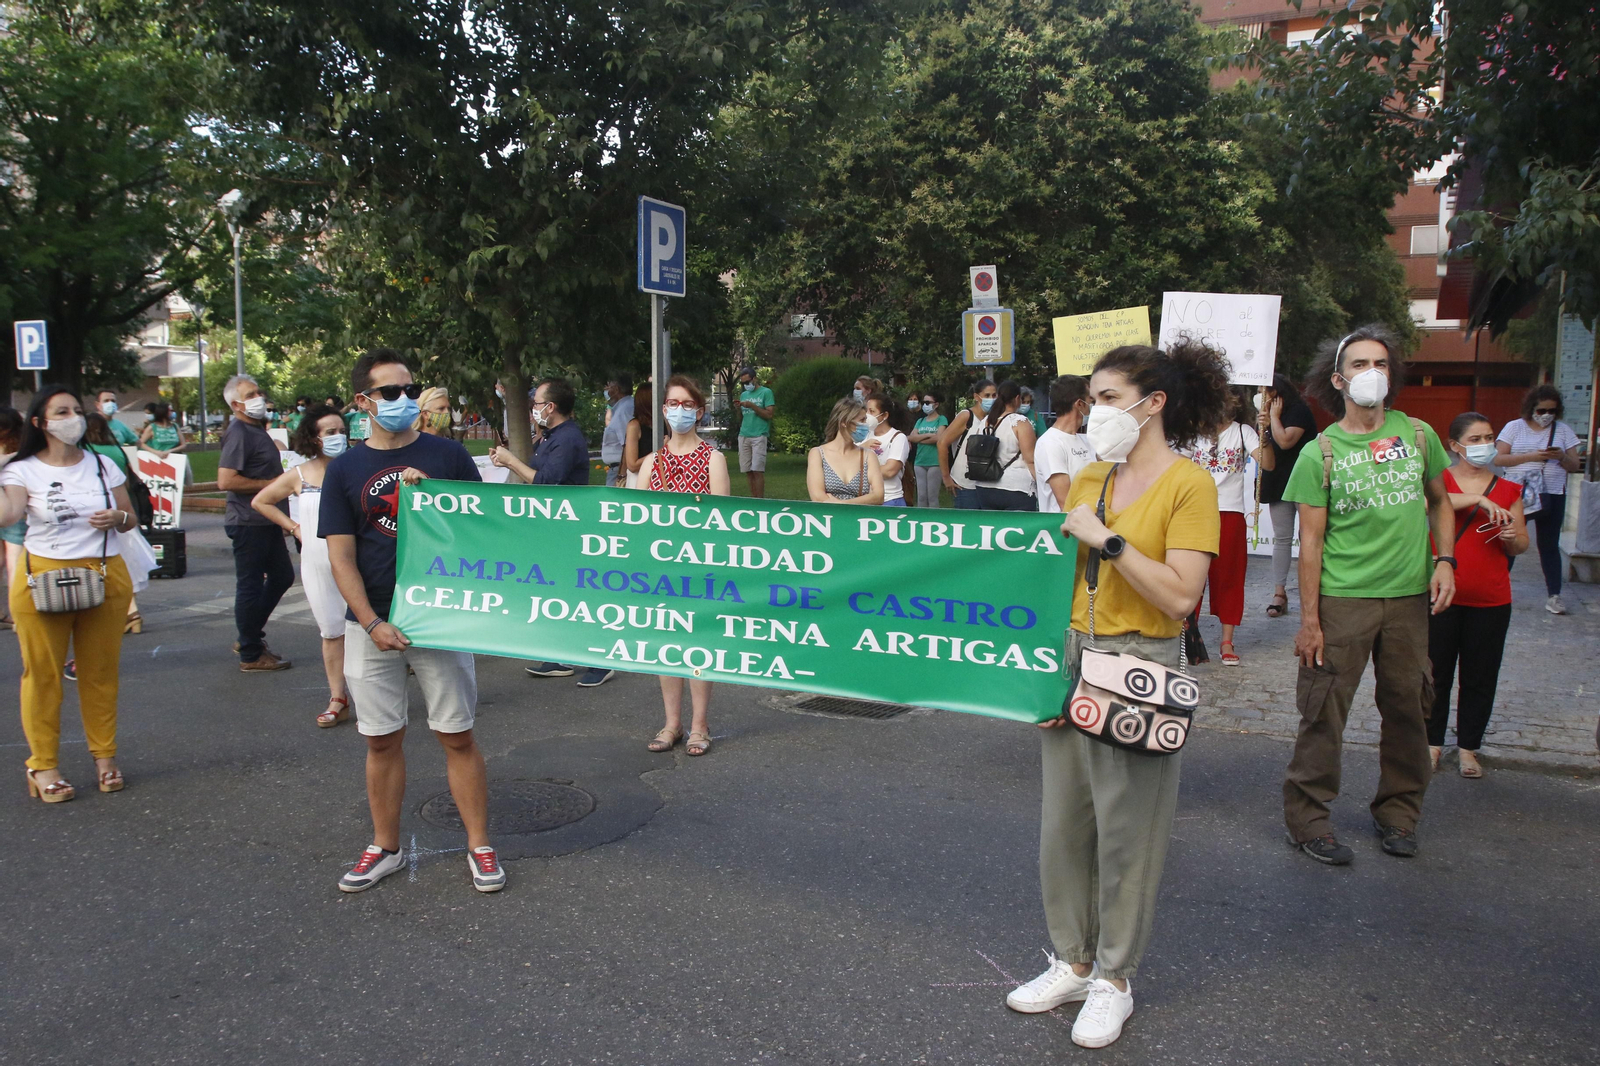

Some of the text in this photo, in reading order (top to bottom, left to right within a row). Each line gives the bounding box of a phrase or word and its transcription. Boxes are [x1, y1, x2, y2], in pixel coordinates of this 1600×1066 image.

[651, 210, 676, 282] P
[1168, 299, 1253, 324] NO al
[21, 327, 40, 364] P
[1375, 446, 1404, 462] CGT
[411, 491, 1063, 556] POR UNA EDUCACIÓN PÚBLICA
[580, 534, 834, 575] DE CALIDAD
[425, 555, 1037, 630] A.M.P.A. ROSALÍA DE CASTRO
[405, 585, 1059, 674] C.E.I.P. JOAQUÍN TENA ARTIGAS
